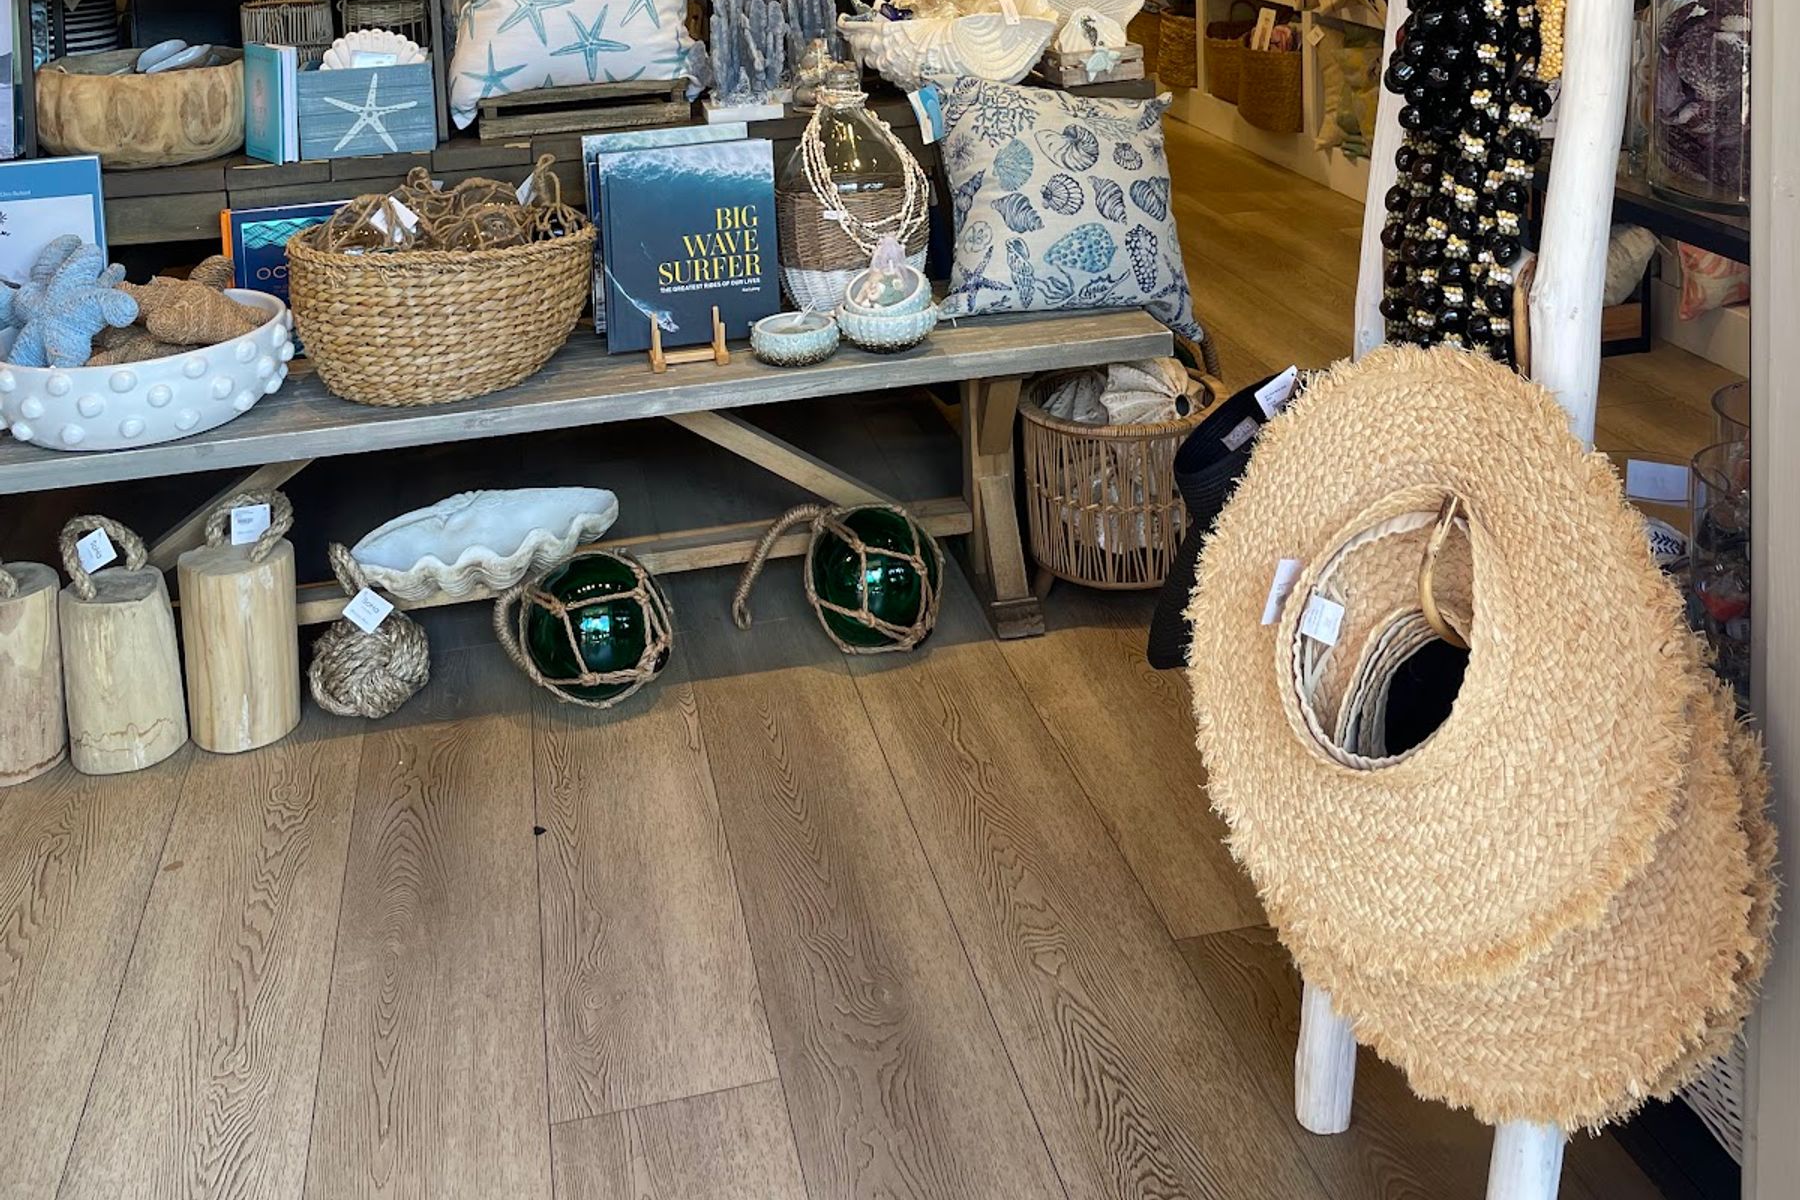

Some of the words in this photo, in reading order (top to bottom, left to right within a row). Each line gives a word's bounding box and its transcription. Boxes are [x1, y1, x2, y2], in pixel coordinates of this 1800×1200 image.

[716, 204, 758, 231] BIG
[682, 230, 759, 258] WAVE
[658, 253, 762, 286] SURFER
[672, 283, 703, 292] GREATEST
[744, 277, 761, 285] LIVES
